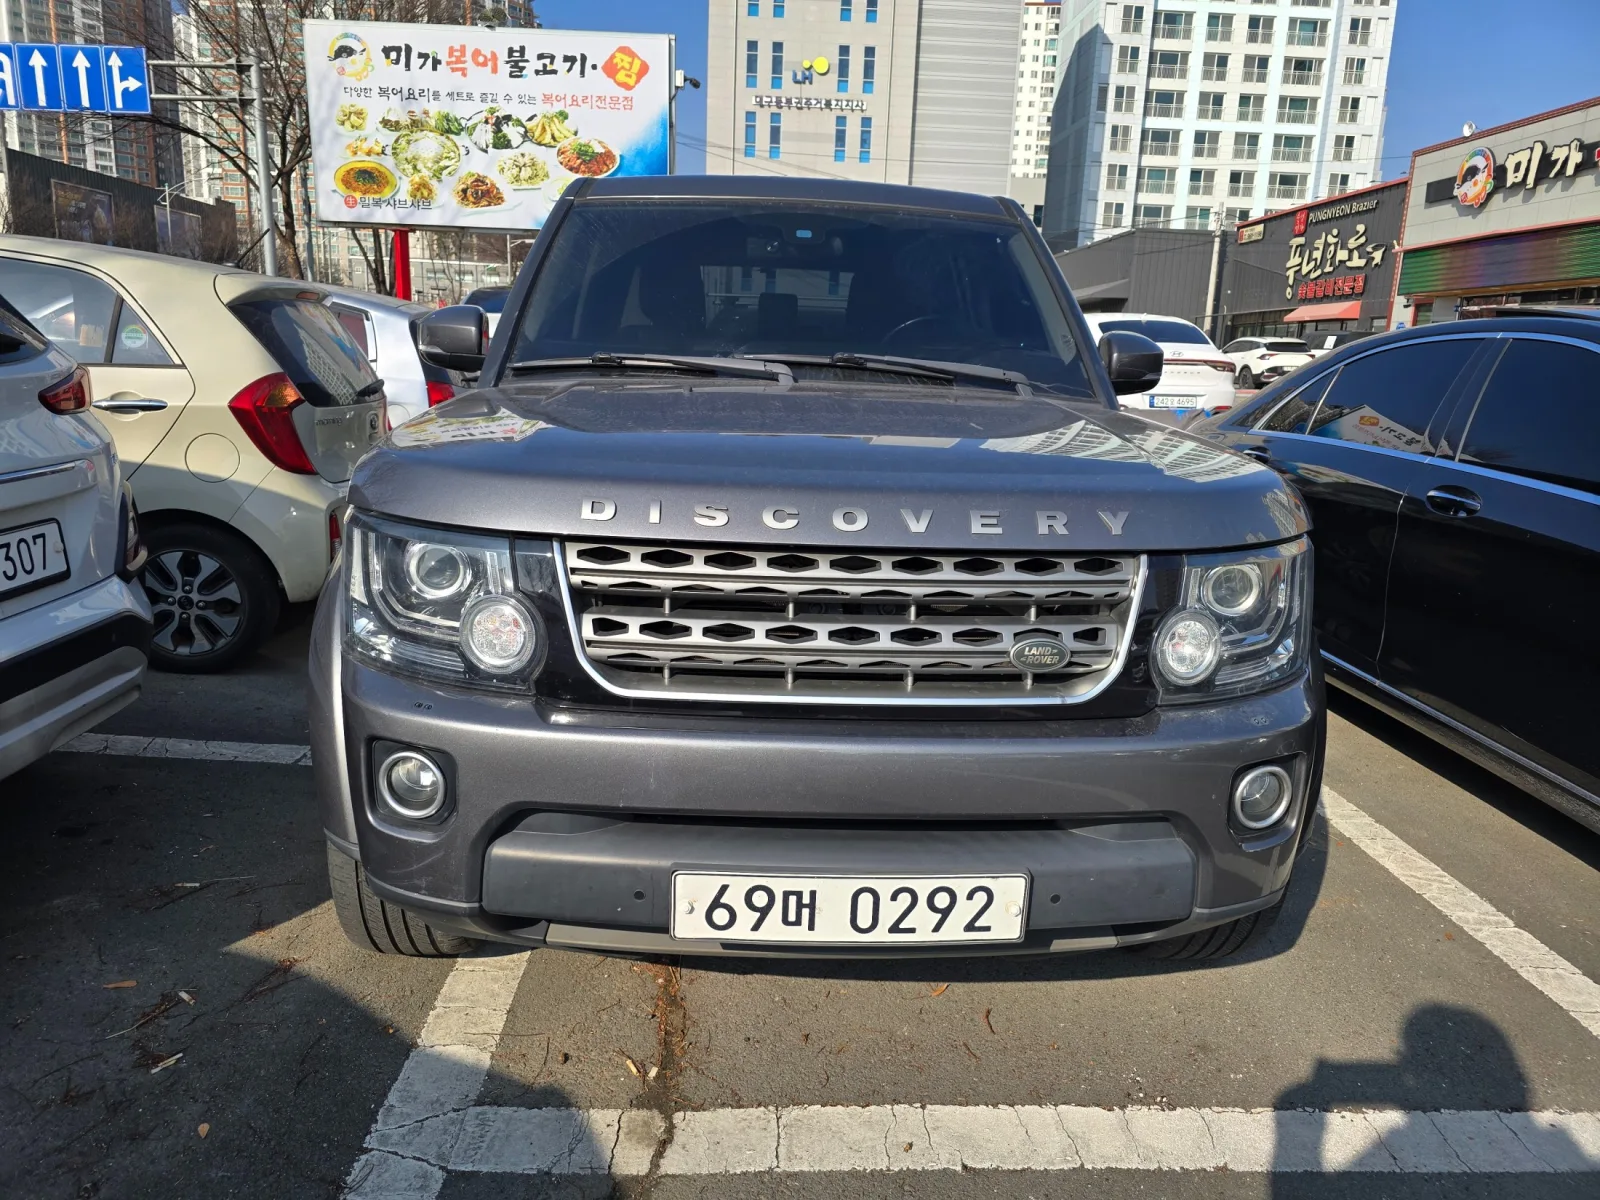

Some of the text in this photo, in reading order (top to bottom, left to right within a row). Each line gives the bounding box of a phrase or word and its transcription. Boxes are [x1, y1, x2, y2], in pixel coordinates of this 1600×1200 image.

[792, 70, 813, 85] LH
[343, 86, 634, 111] 다양한 복어요리를 세트로 즐길 수 있는 복어요리전문점
[1308, 203, 1351, 223] PUNGNYEON
[1351, 200, 1378, 213] Brazier
[1298, 273, 1365, 299] 숯불갈비전문점
[1177, 398, 1195, 406] 4695
[580, 499, 1131, 536] DISCOVERY
[0, 533, 47, 581] 307
[1024, 647, 1052, 655] LAND
[1026, 656, 1060, 664] ROVER
[849, 885, 995, 935] 0292
